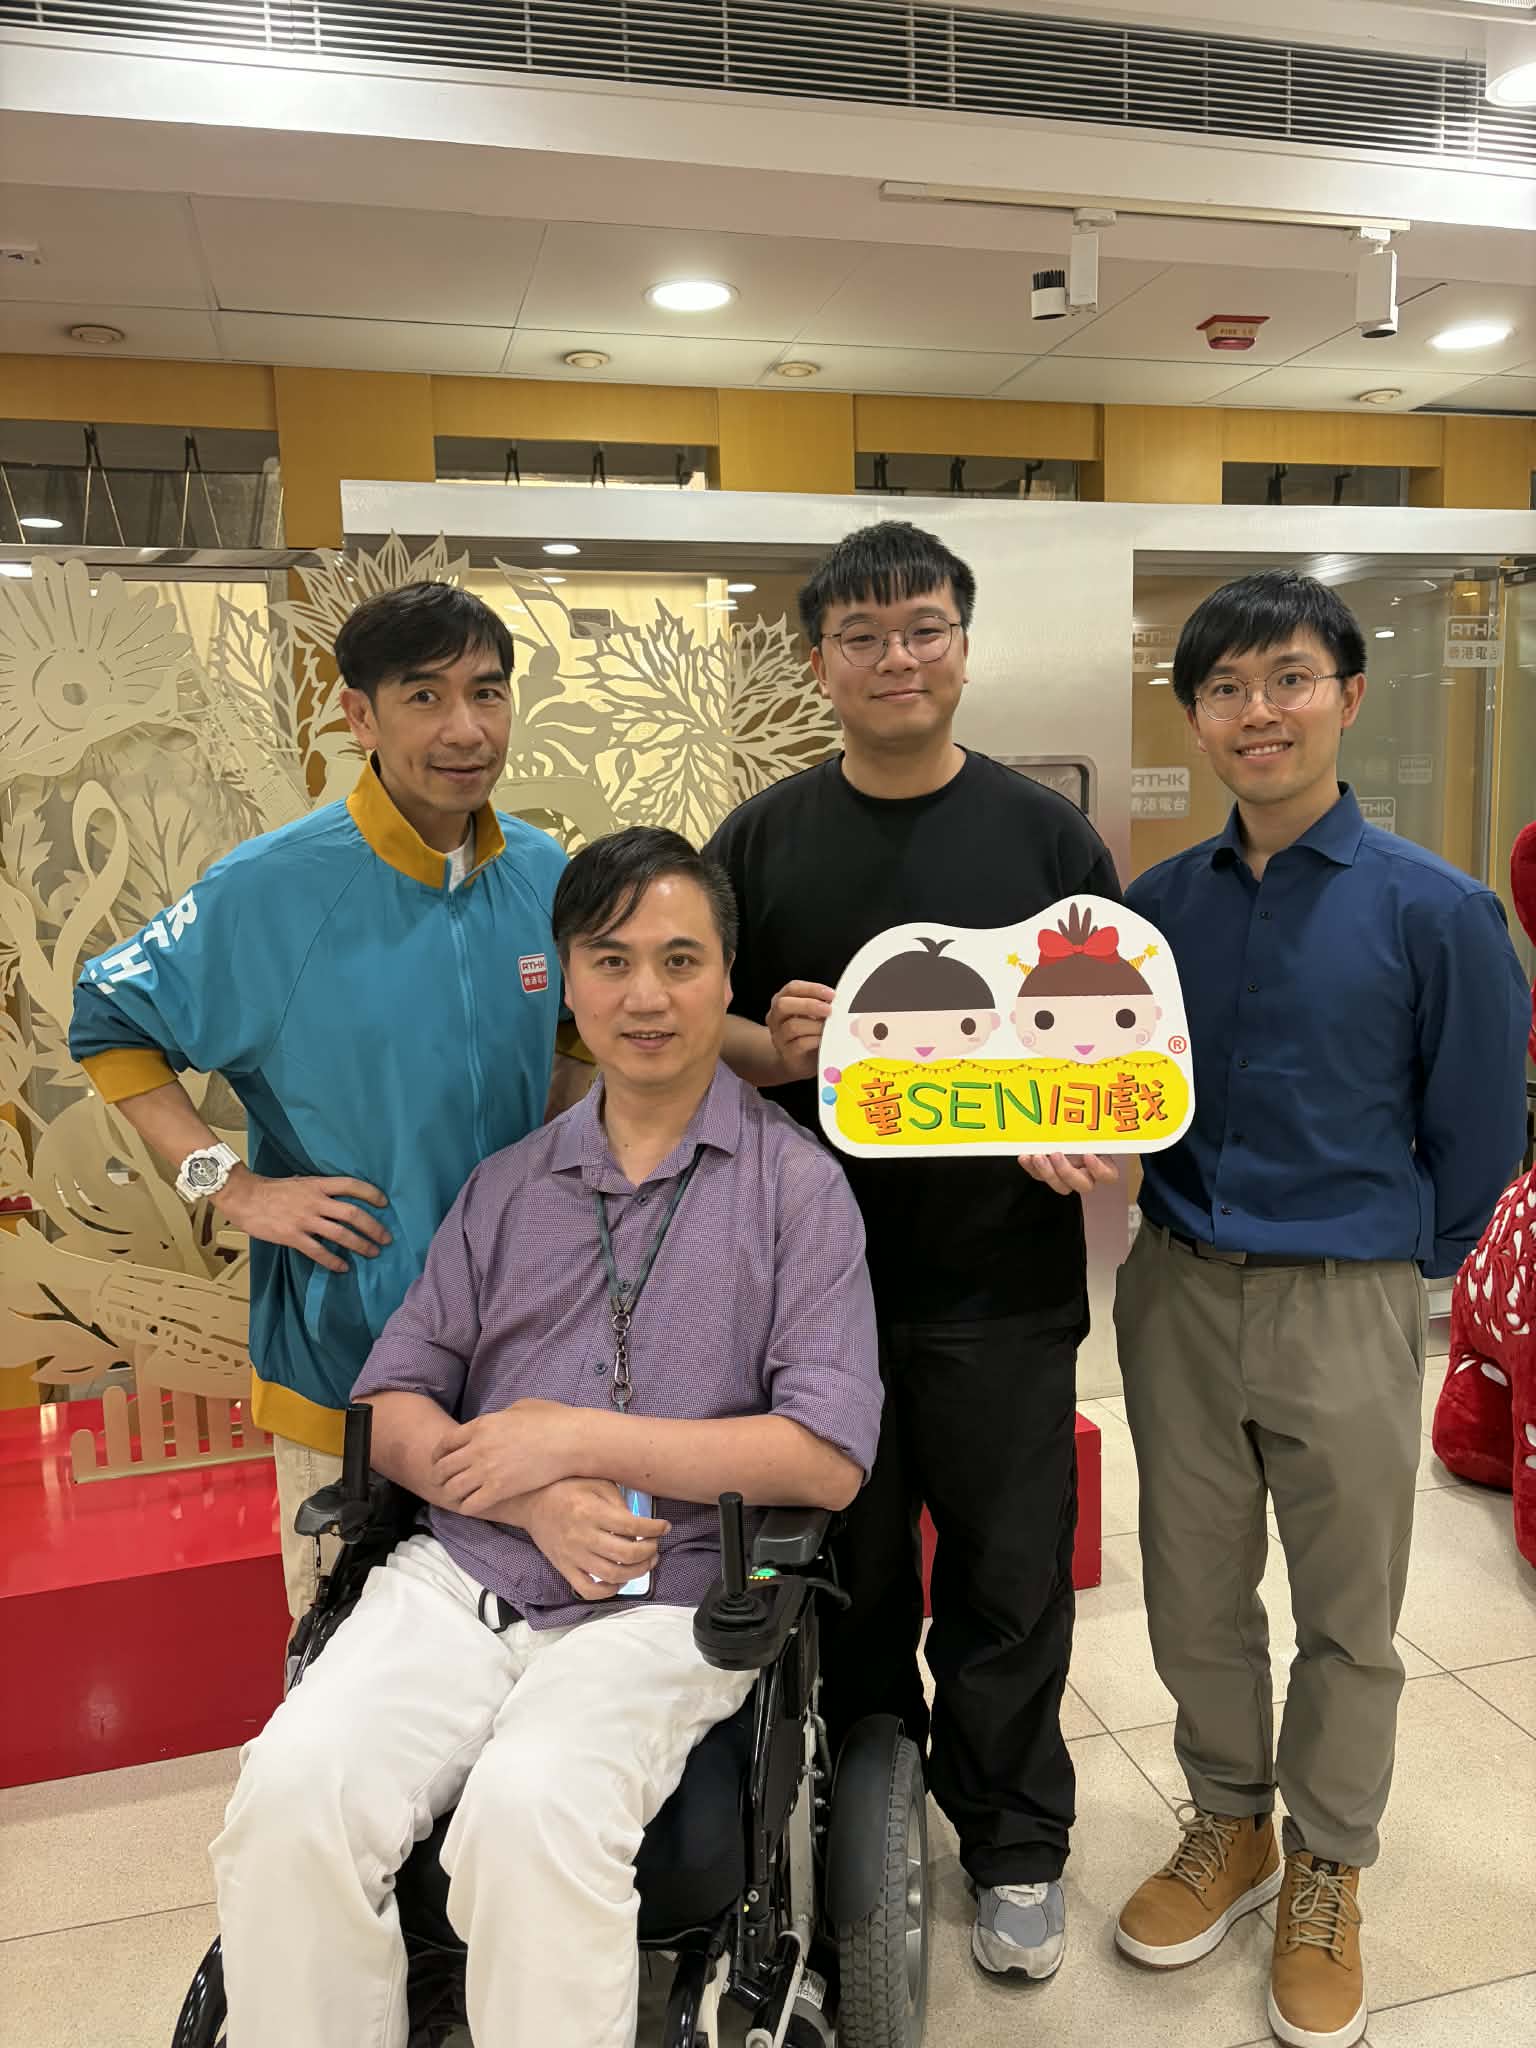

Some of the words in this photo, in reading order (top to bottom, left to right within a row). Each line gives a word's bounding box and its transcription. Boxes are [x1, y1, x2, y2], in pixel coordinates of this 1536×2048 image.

[1450, 623, 1497, 637] RTHK
[1131, 773, 1185, 787] RTHK
[1359, 801, 1393, 817] THK
